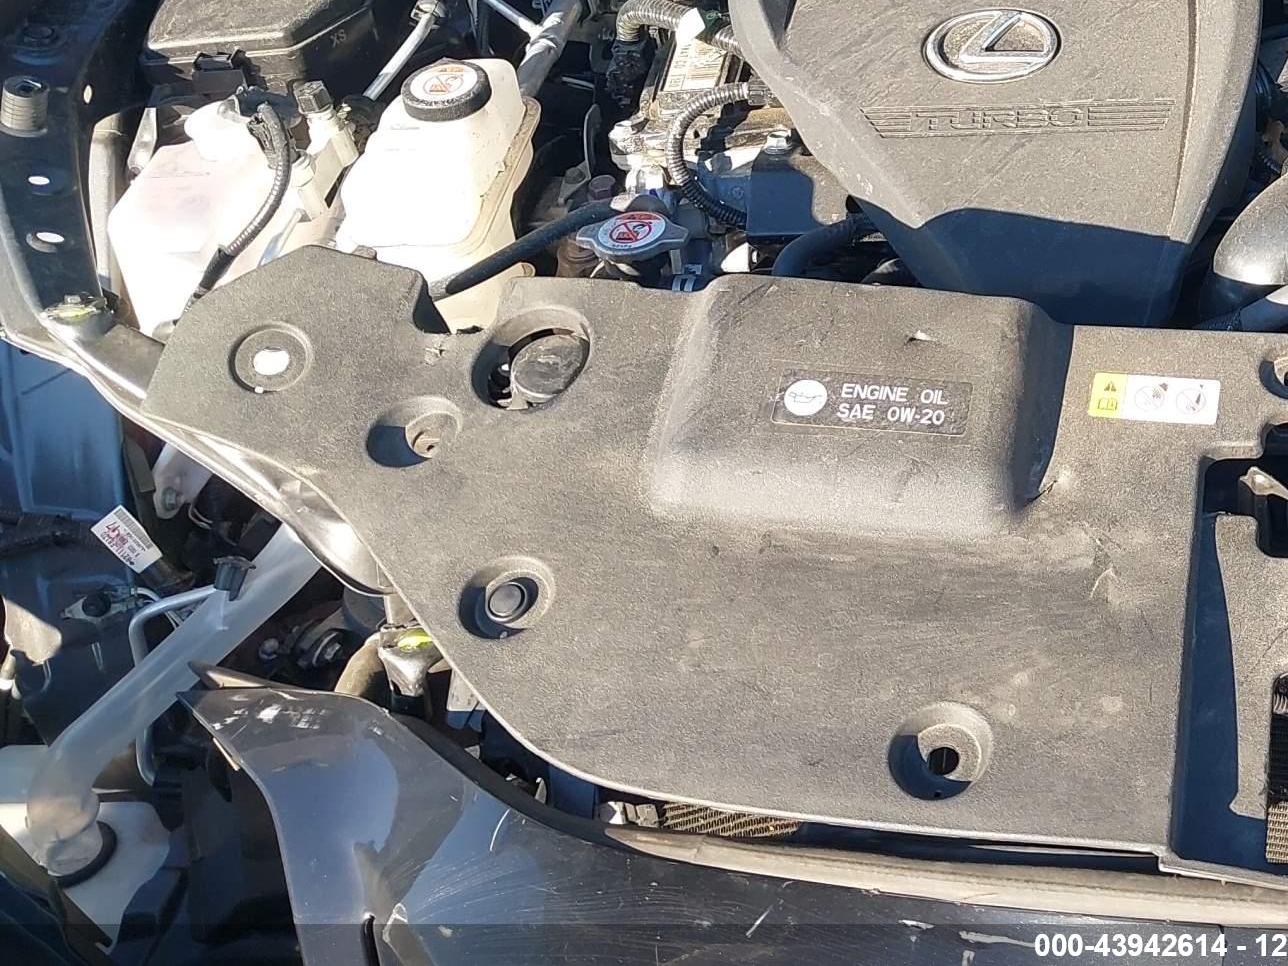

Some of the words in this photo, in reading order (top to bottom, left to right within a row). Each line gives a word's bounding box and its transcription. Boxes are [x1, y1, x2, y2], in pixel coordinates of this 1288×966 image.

[915, 108, 1084, 131] TURBO
[840, 383, 909, 402] ENGINE
[920, 389, 950, 405] OIL
[836, 403, 876, 420] SAE
[887, 407, 946, 425] 0W-20
